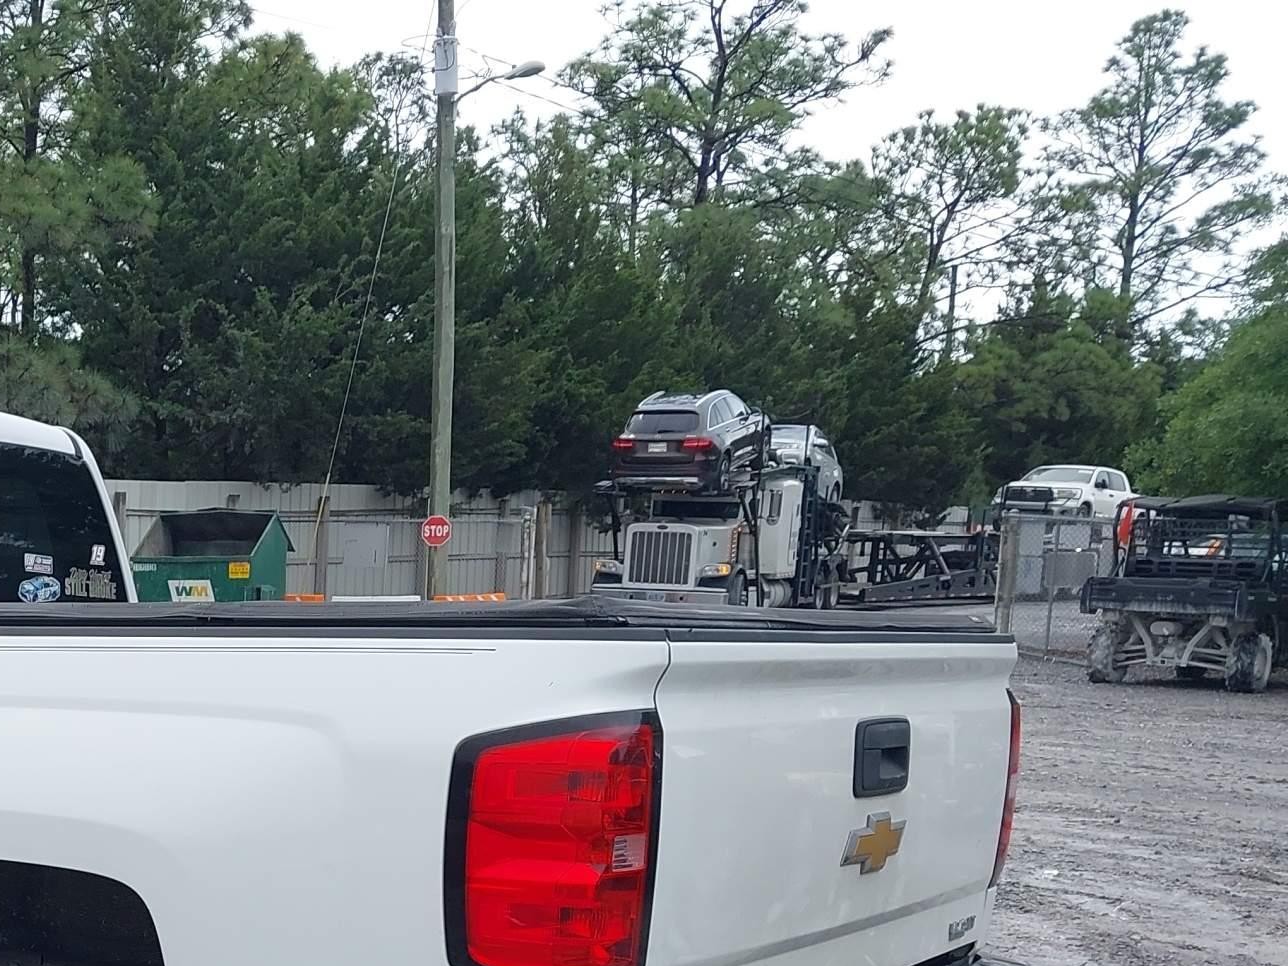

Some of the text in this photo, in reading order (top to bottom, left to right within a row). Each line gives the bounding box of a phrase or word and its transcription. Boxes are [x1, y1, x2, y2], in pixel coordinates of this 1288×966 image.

[424, 525, 449, 537] STOP
[91, 545, 105, 561] 19
[175, 585, 209, 597] WM
